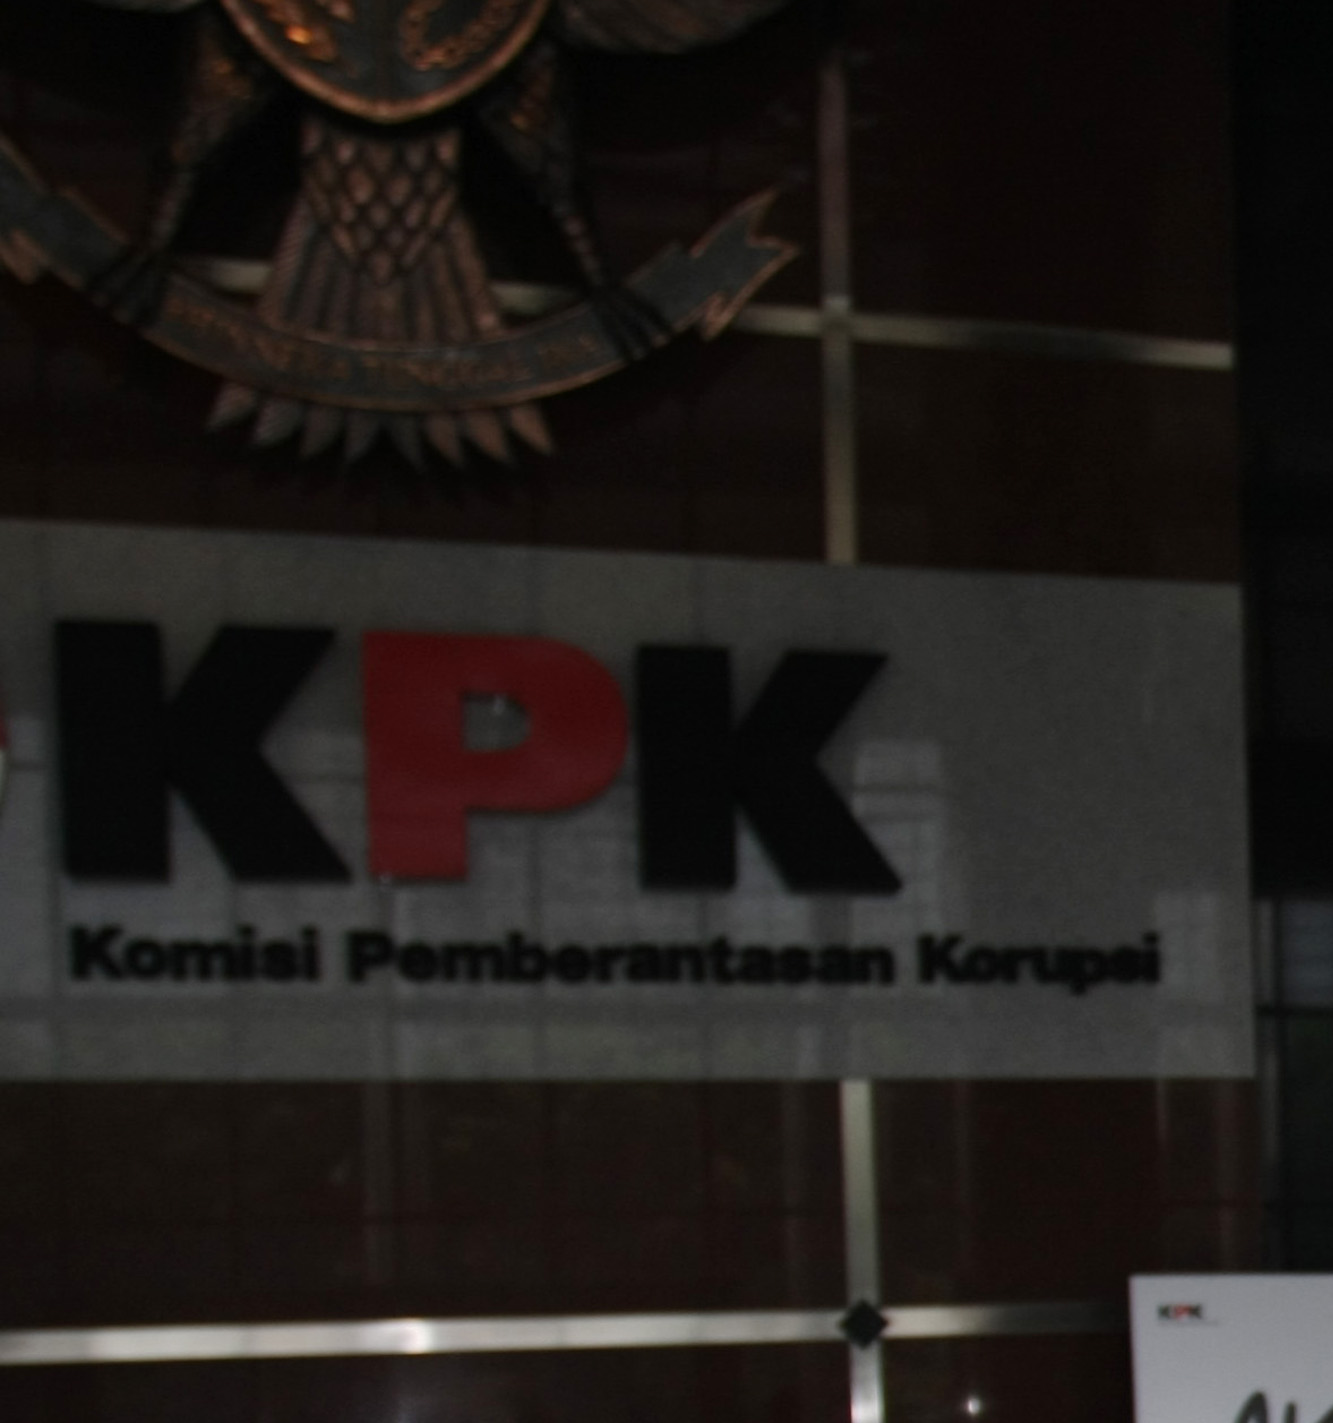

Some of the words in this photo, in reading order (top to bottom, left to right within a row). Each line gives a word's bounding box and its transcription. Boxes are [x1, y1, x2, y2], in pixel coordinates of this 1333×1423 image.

[53, 618, 902, 895] KPK
[70, 926, 322, 984] Komisi
[347, 929, 895, 985] Pemberantasan
[918, 933, 1161, 996] Korupsi
